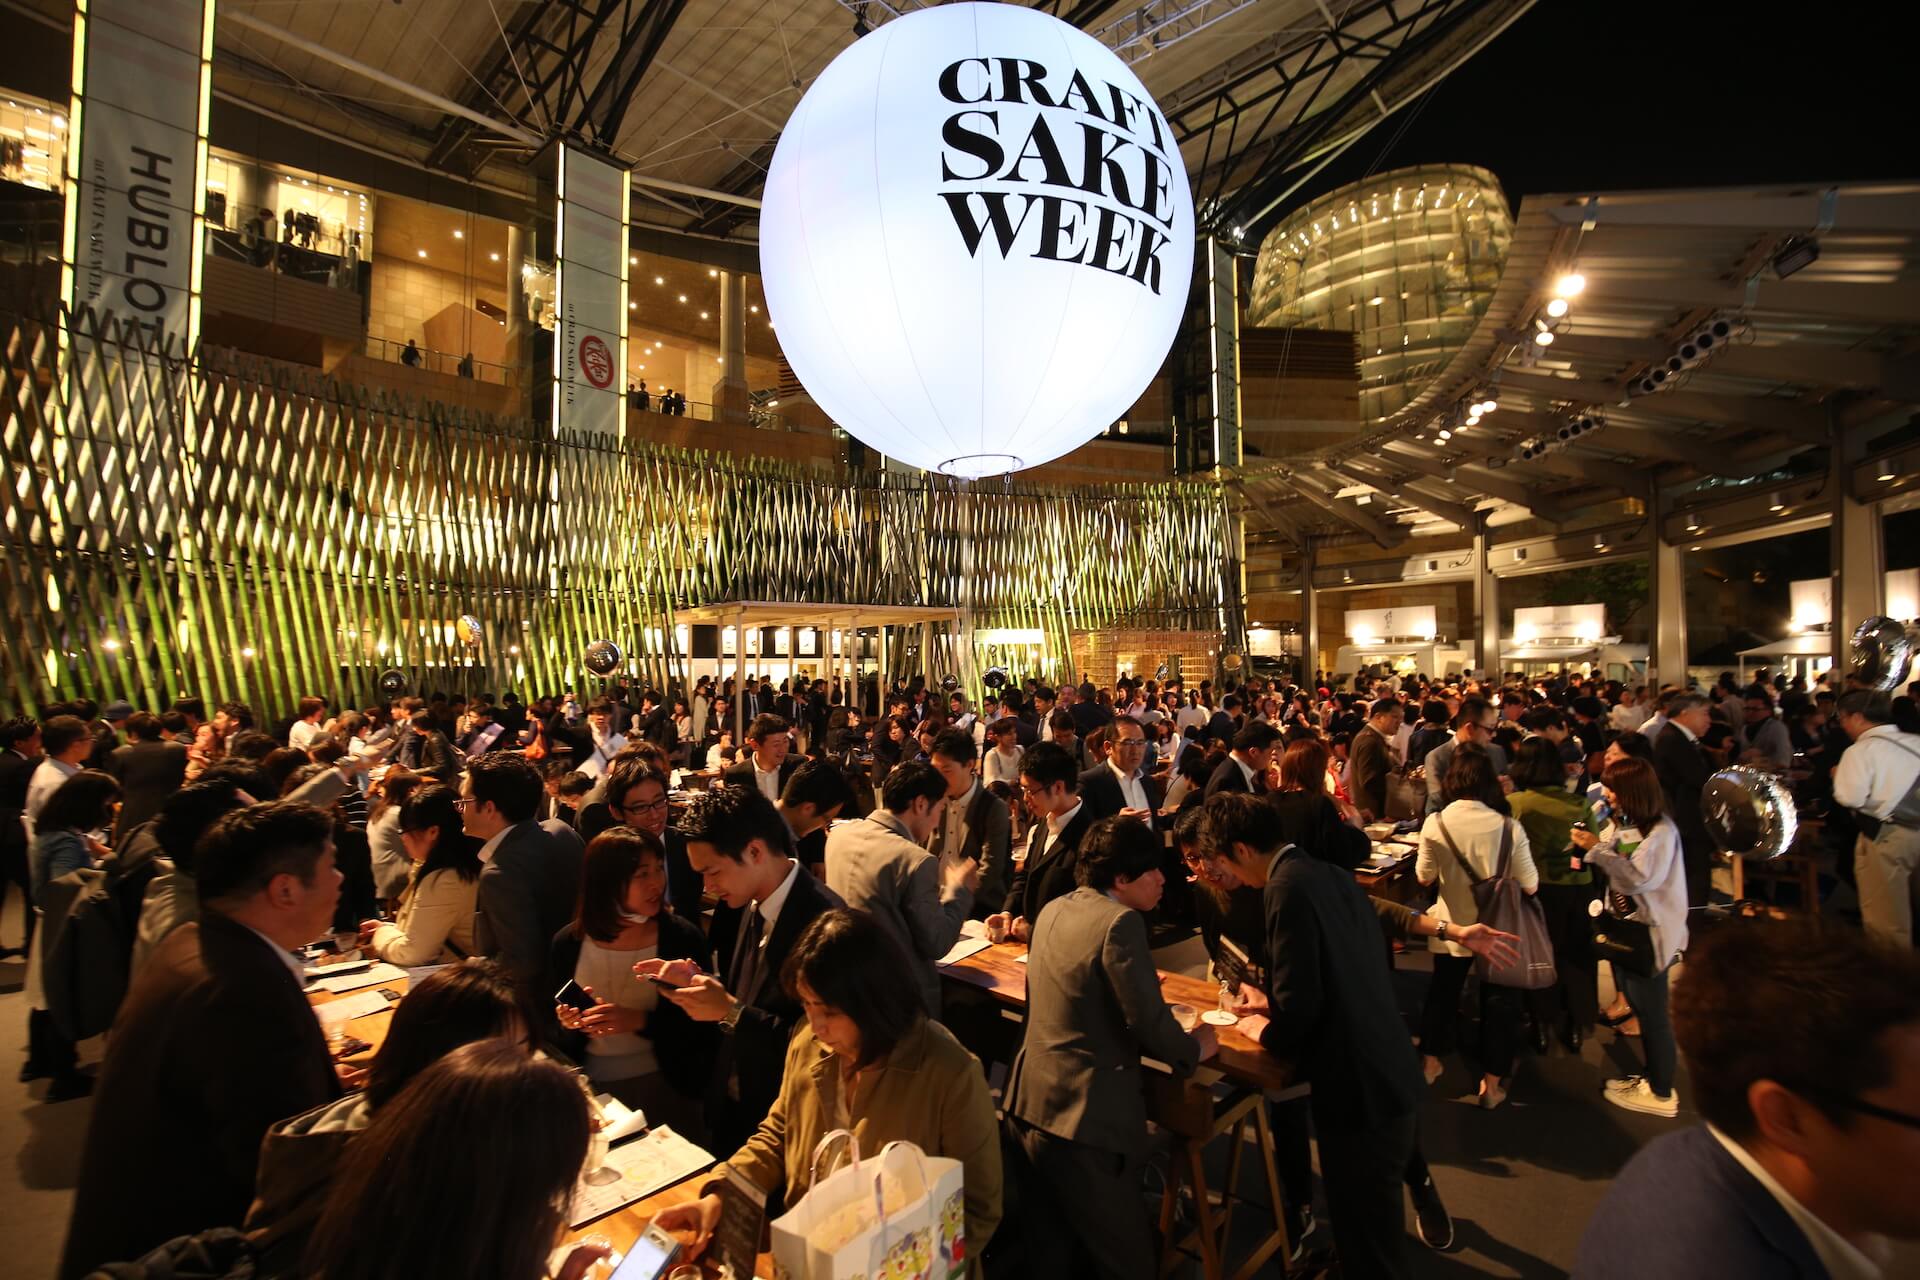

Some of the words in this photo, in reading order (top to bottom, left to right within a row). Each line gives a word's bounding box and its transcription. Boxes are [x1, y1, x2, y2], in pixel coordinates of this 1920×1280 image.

[938, 57, 1169, 158] CRAFT
[941, 111, 1175, 230] SAKE
[937, 192, 1171, 295] WEEK
